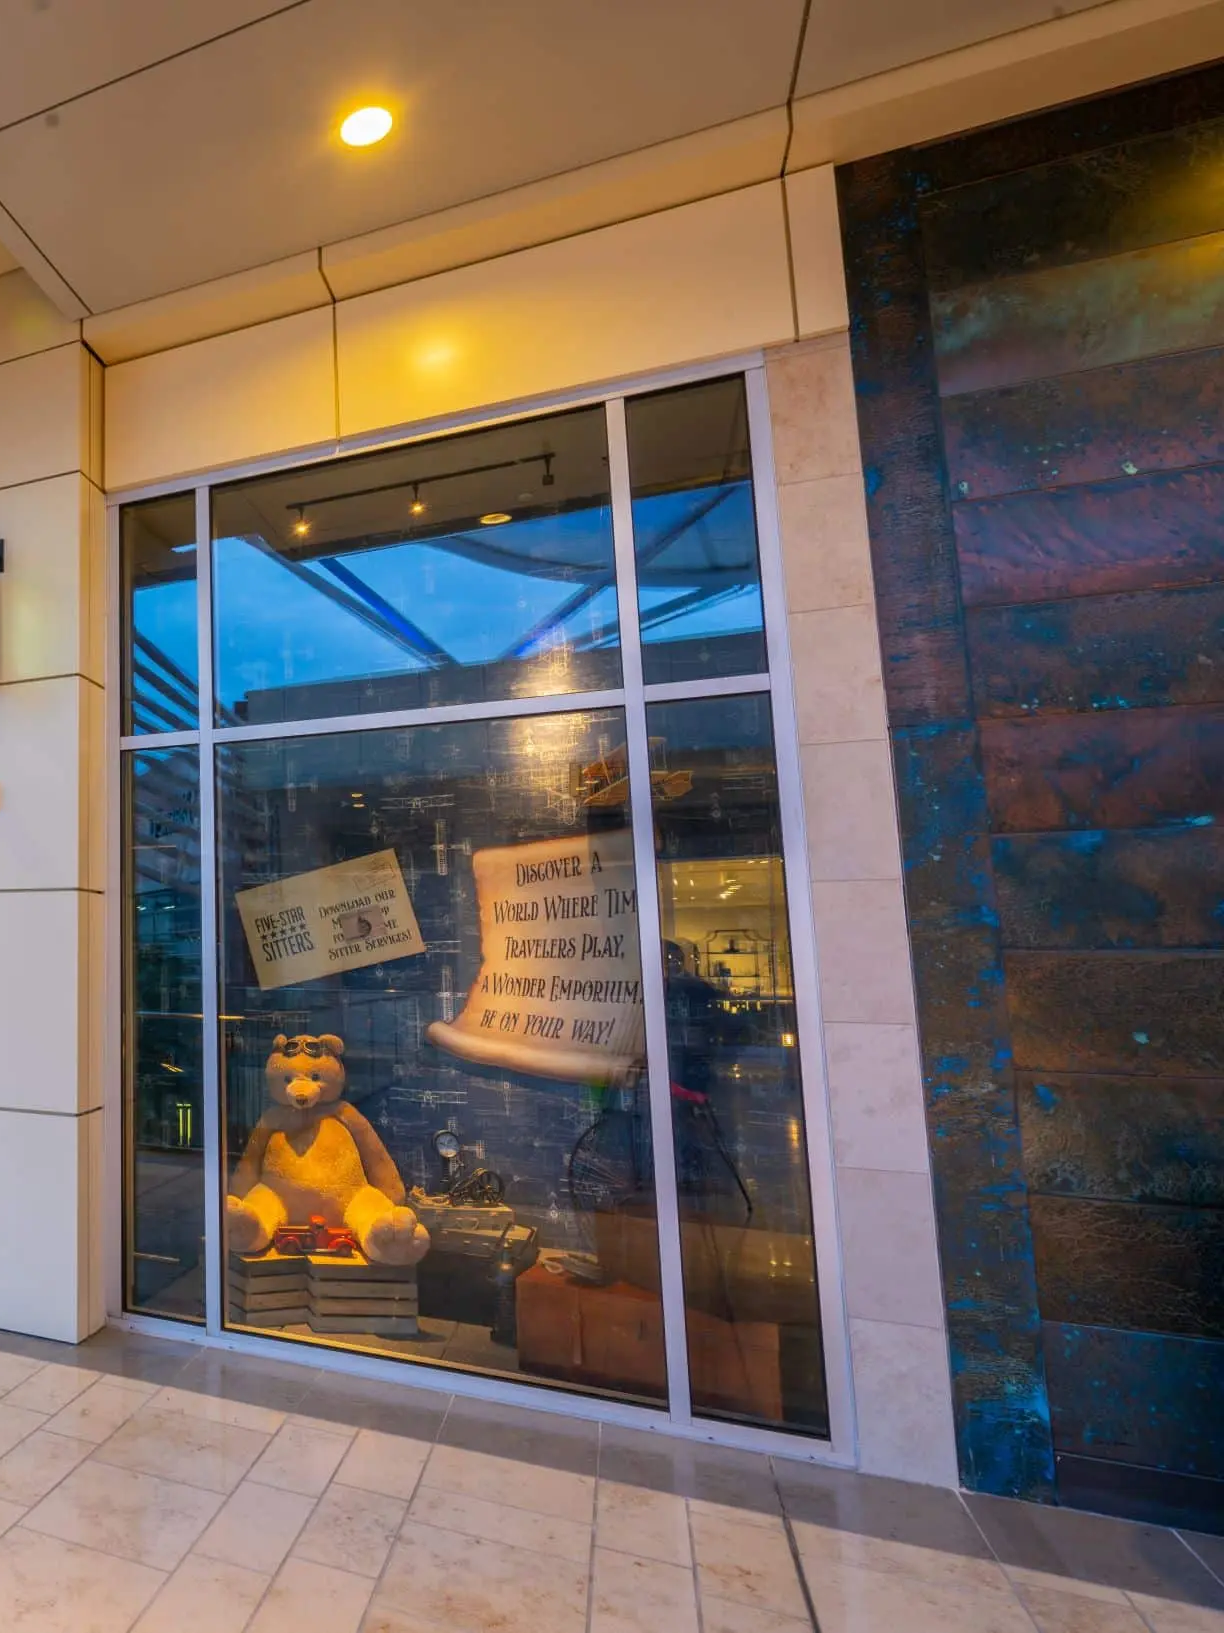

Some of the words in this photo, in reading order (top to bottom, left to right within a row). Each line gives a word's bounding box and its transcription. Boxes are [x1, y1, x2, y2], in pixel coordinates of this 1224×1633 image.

[516, 855, 582, 887] DISCOVER
[591, 852, 602, 874] A
[255, 906, 306, 933] FIVE-STAR
[319, 896, 371, 919] DOWNLOAD
[375, 889, 396, 903] OUR
[493, 900, 539, 924] WORLD
[544, 894, 599, 922] WHERE
[605, 888, 638, 918] TIM
[262, 931, 314, 962] SITTERS
[328, 943, 362, 961] SITTER
[365, 929, 413, 950] SERVICES!
[505, 936, 576, 960] TRAVELERS
[581, 933, 625, 961] PLAY,
[481, 975, 489, 993] A
[493, 972, 546, 998] WONDER
[480, 1009, 497, 1029] BE
[499, 1011, 520, 1033] ON
[523, 1013, 564, 1039] YOUR
[571, 1017, 616, 1045] WAY!
